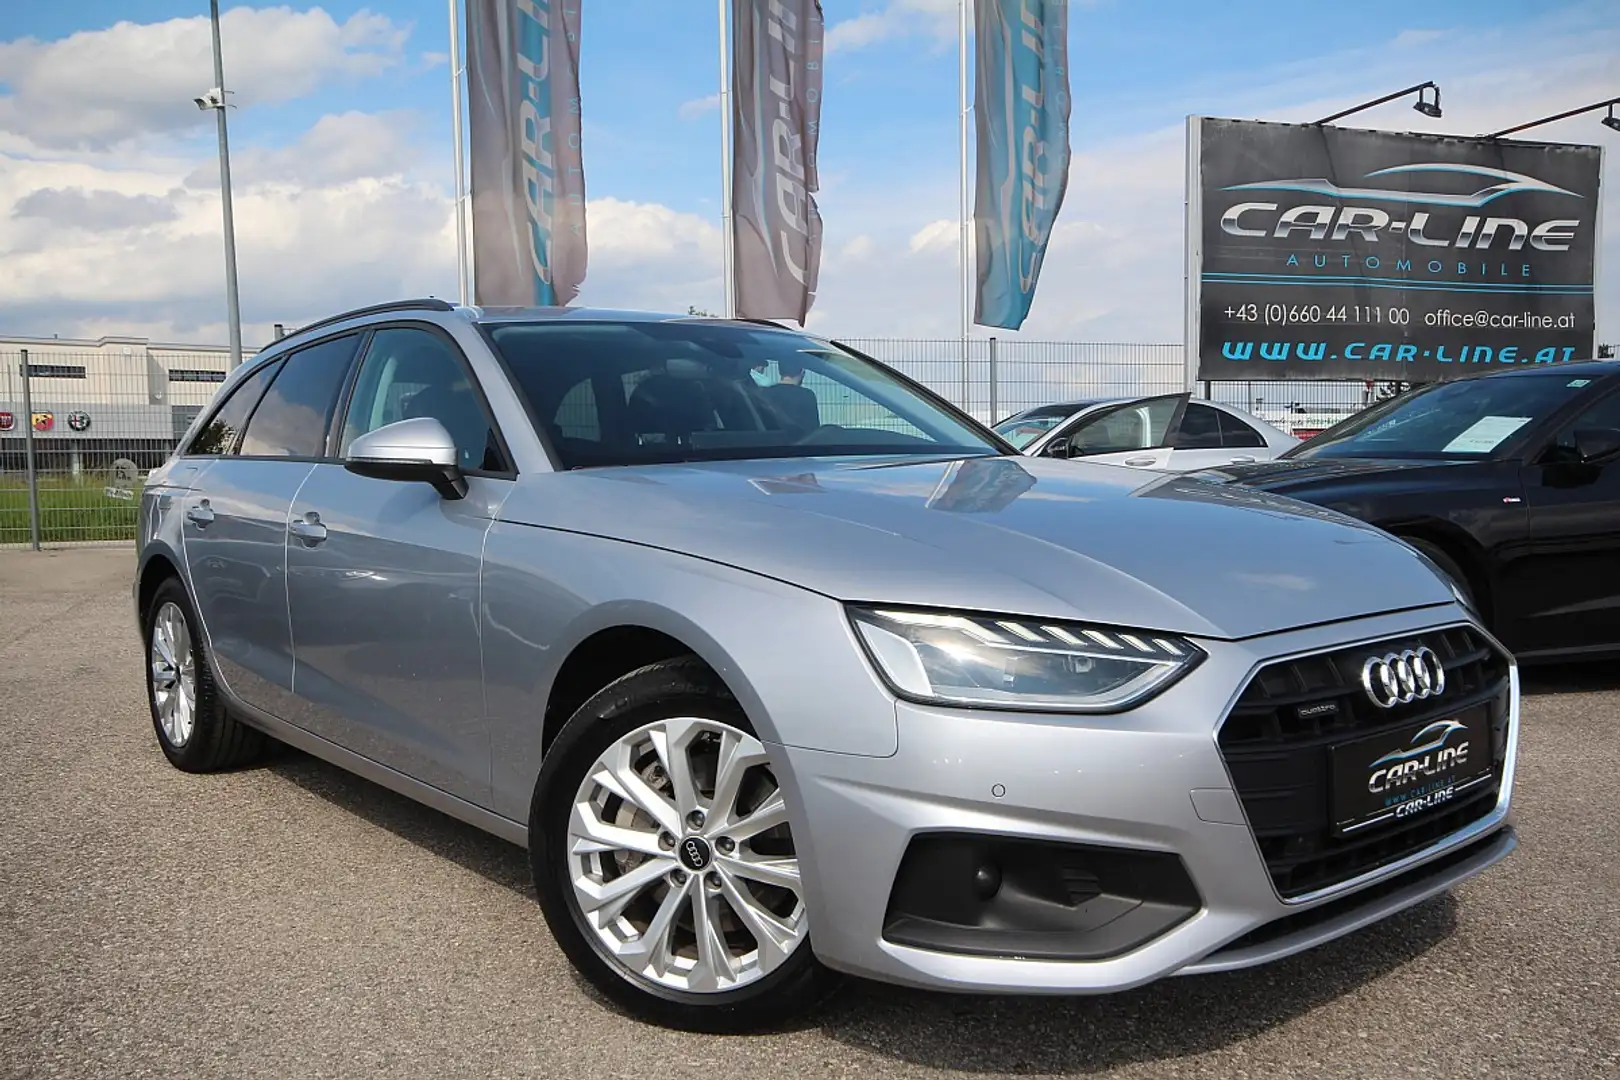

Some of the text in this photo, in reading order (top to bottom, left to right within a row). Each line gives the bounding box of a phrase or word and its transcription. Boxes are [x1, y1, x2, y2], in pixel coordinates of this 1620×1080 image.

[517, 0, 554, 285] CAR-LI
[1220, 202, 1580, 251] CAR-LINE
[1286, 253, 1531, 277] AUTOMOBILE
[1224, 304, 1575, 329] +43 (0)660 44 111 00 office@car-line.at
[1368, 741, 1469, 793] CAR-LINE
[1396, 786, 1454, 817] CAR-LINE
